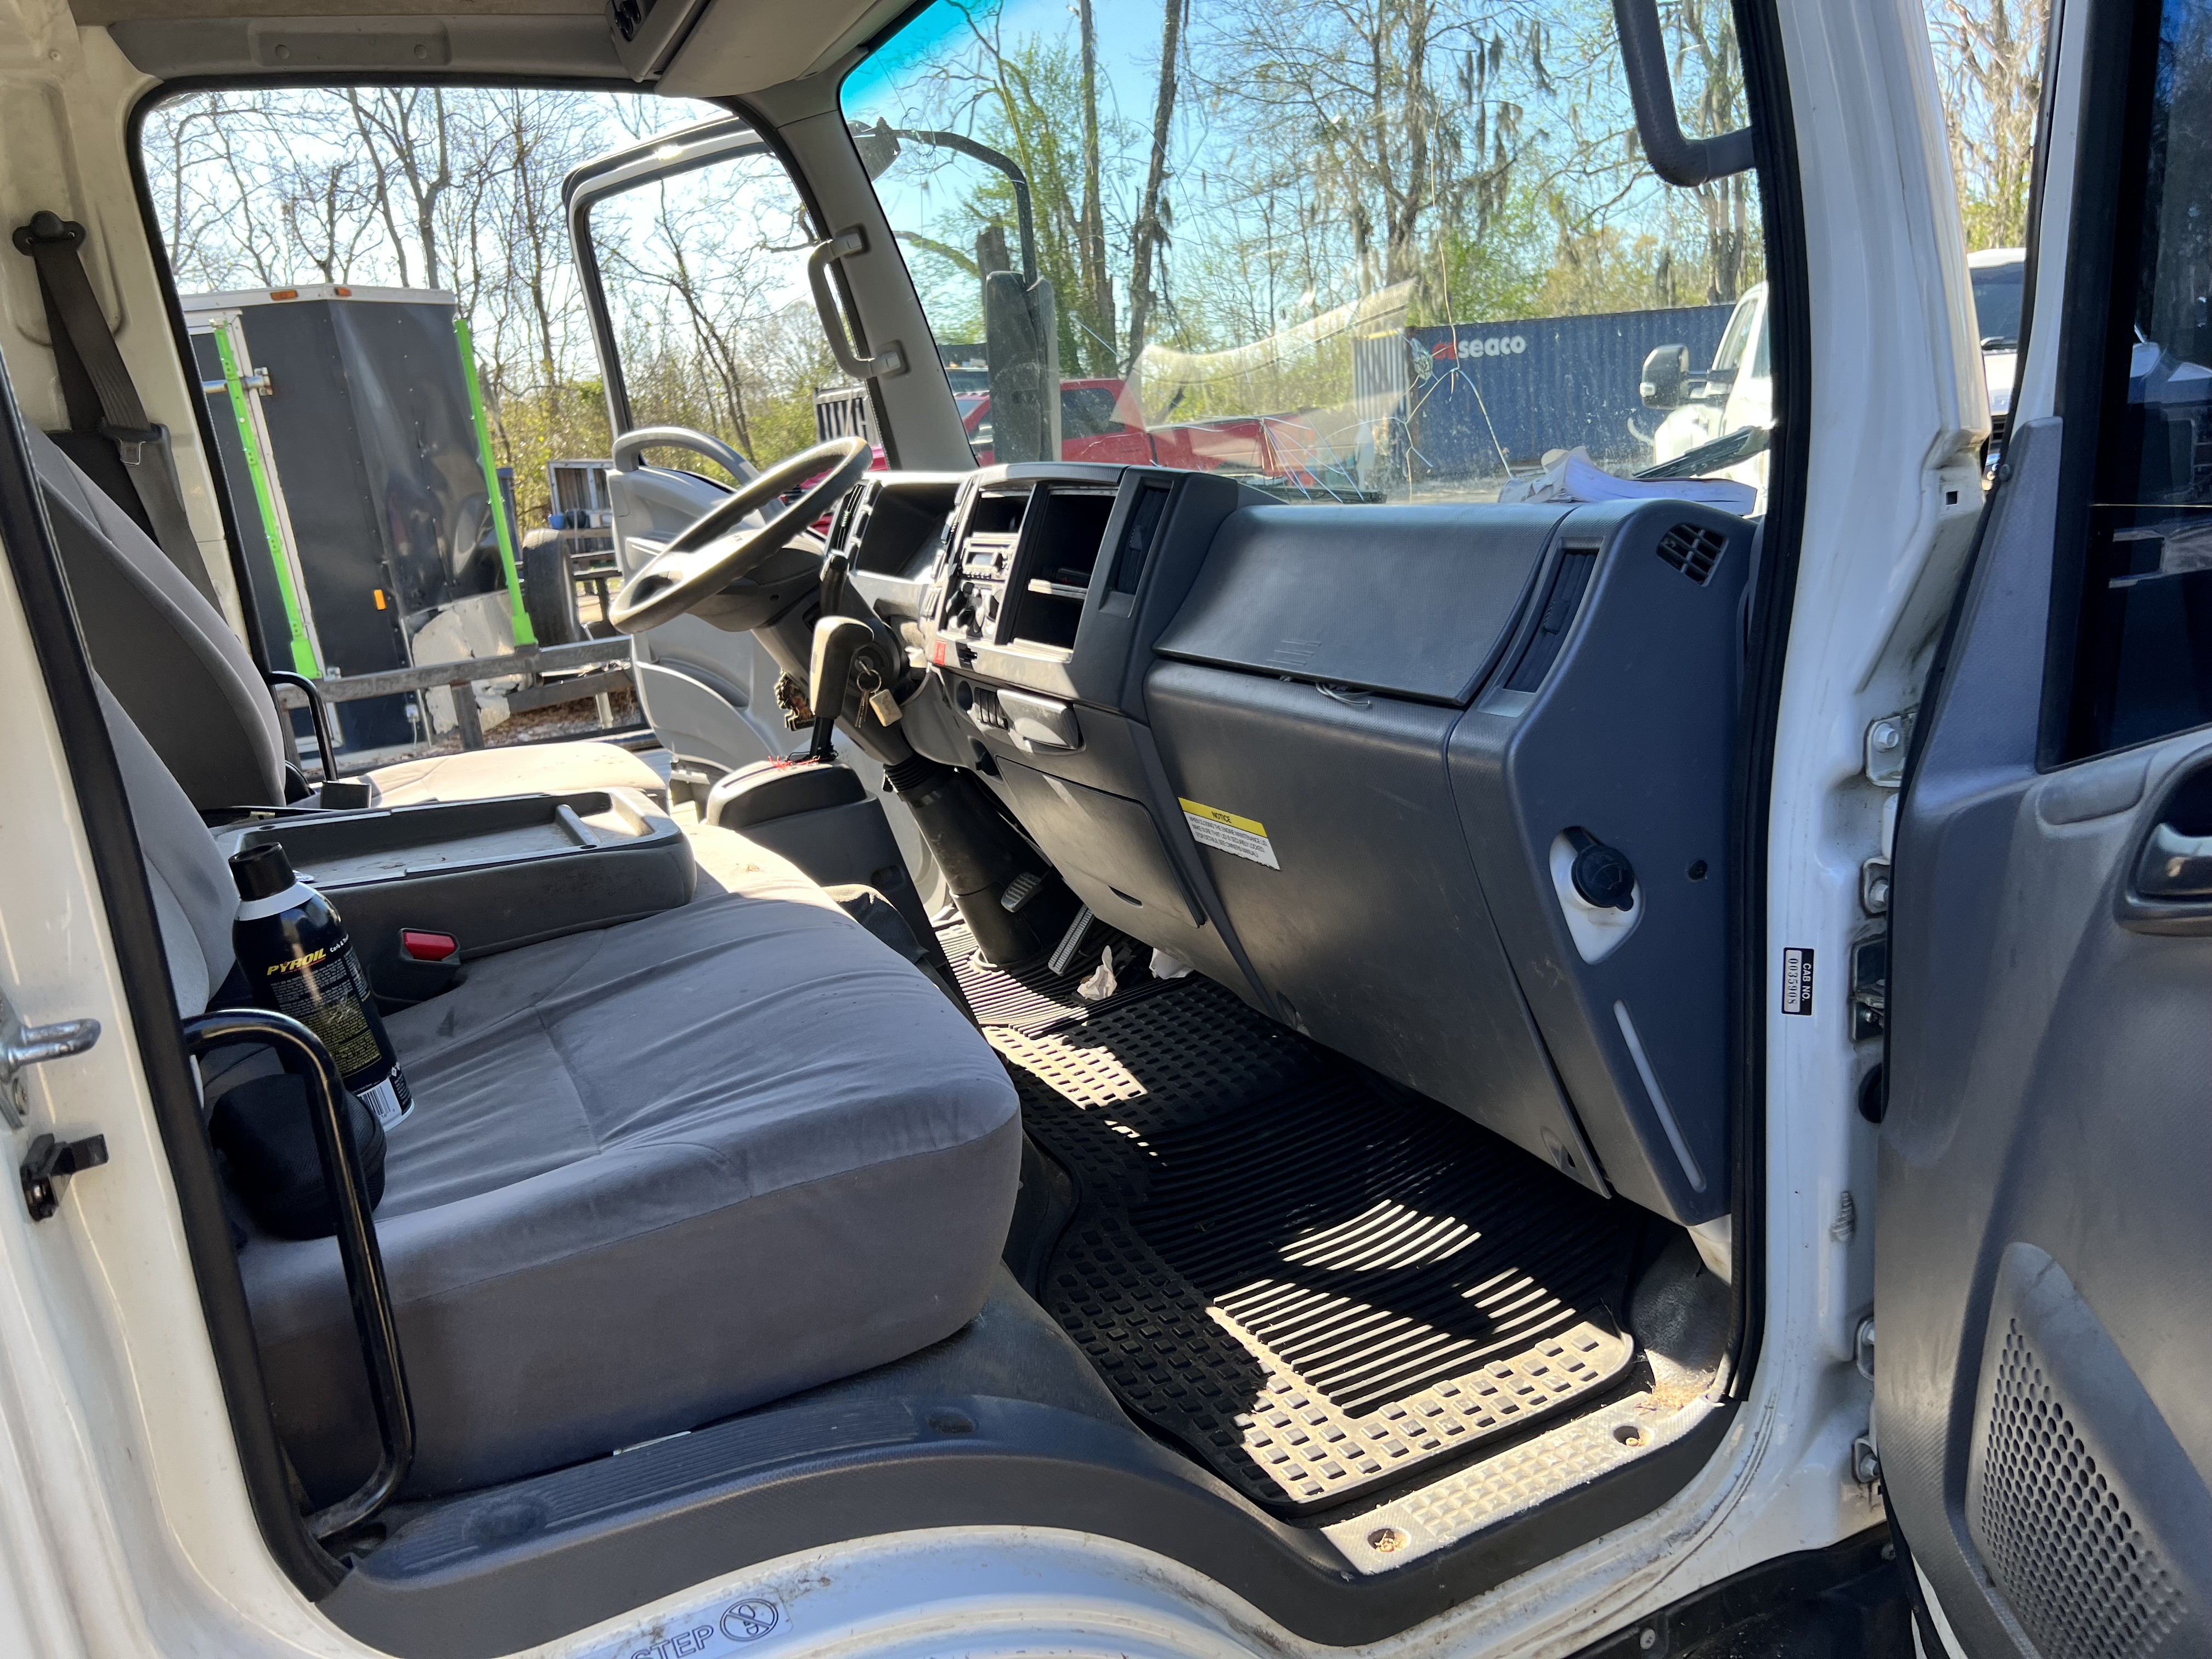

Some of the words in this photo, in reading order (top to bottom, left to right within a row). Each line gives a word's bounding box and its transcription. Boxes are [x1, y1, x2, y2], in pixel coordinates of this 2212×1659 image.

[1211, 811, 1232, 823] NOTICE
[267, 948, 326, 975] PYROIL
[1787, 958, 1798, 1004] 0035908
[1803, 963, 1812, 982] CAB
[1802, 985, 1812, 1001] NO.
